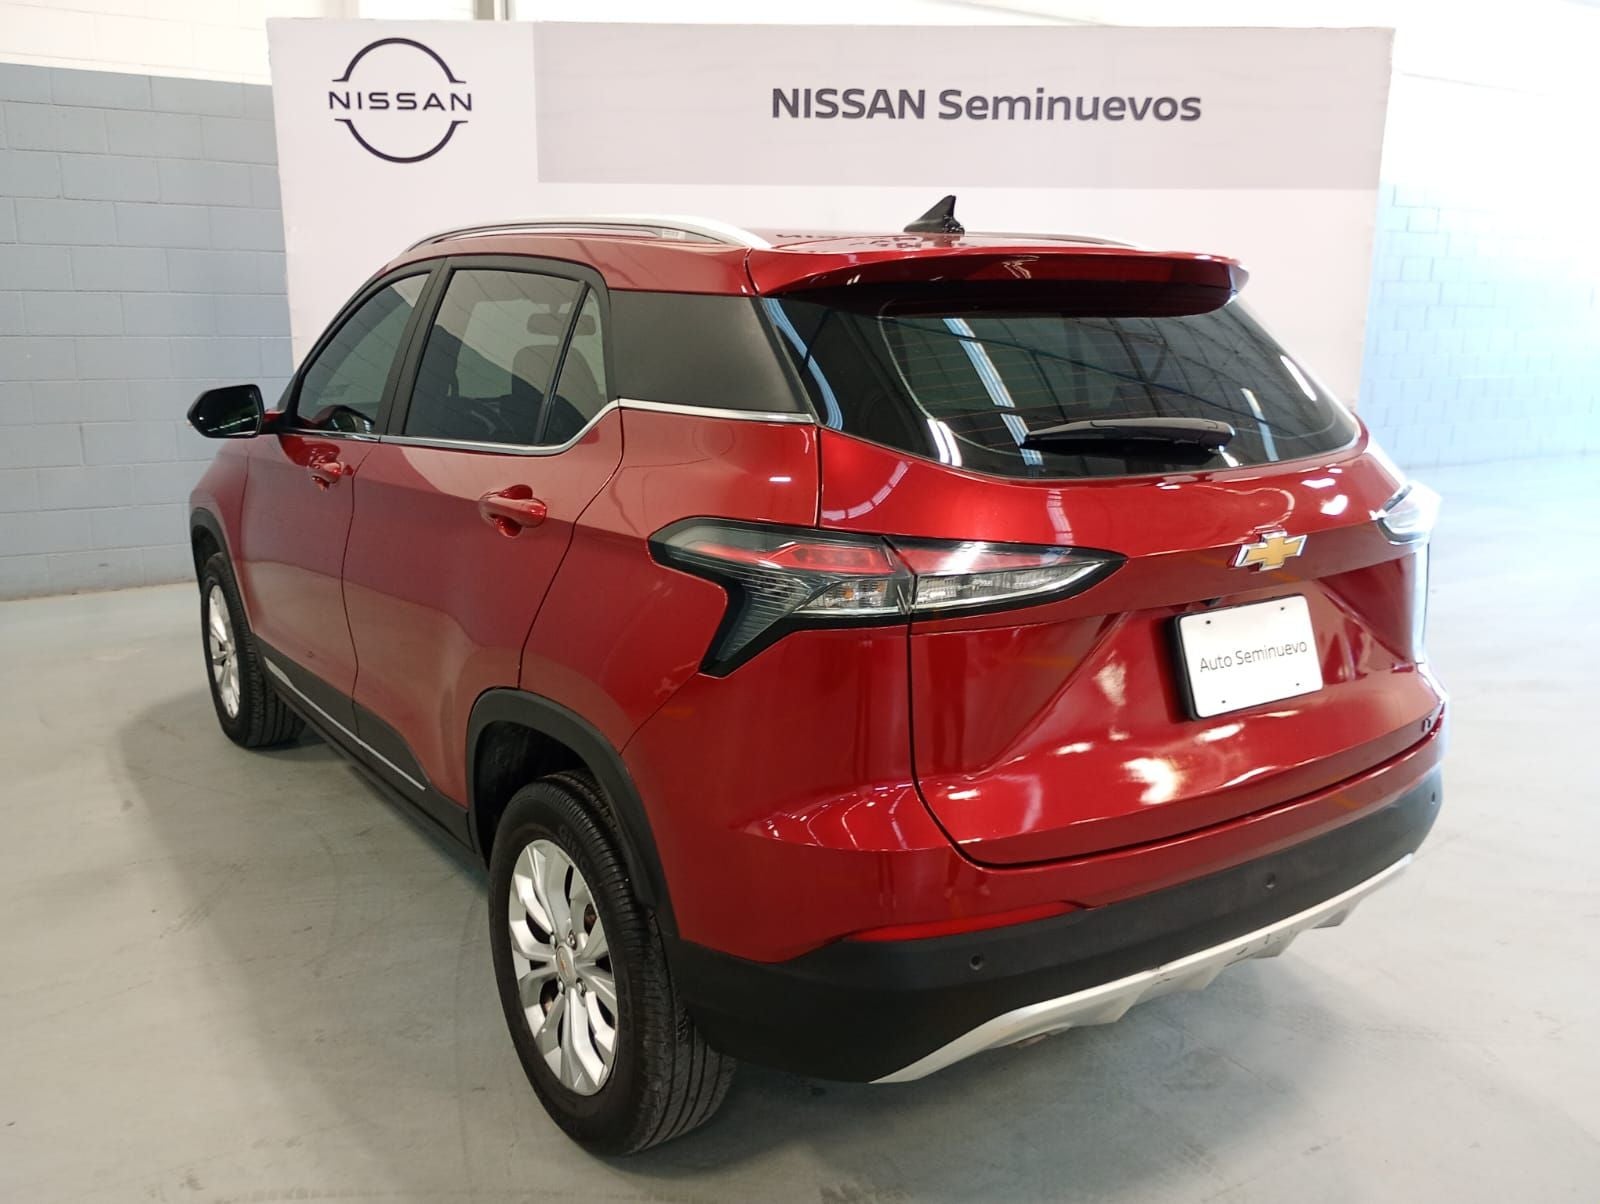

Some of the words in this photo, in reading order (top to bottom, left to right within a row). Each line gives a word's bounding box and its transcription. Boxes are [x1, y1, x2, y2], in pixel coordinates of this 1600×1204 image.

[328, 91, 473, 112] NISSAN
[772, 87, 926, 120] NISSAN
[938, 86, 1203, 122] Seminuevos
[1199, 655, 1233, 672] Auto
[1235, 641, 1308, 665] Seminuevo
